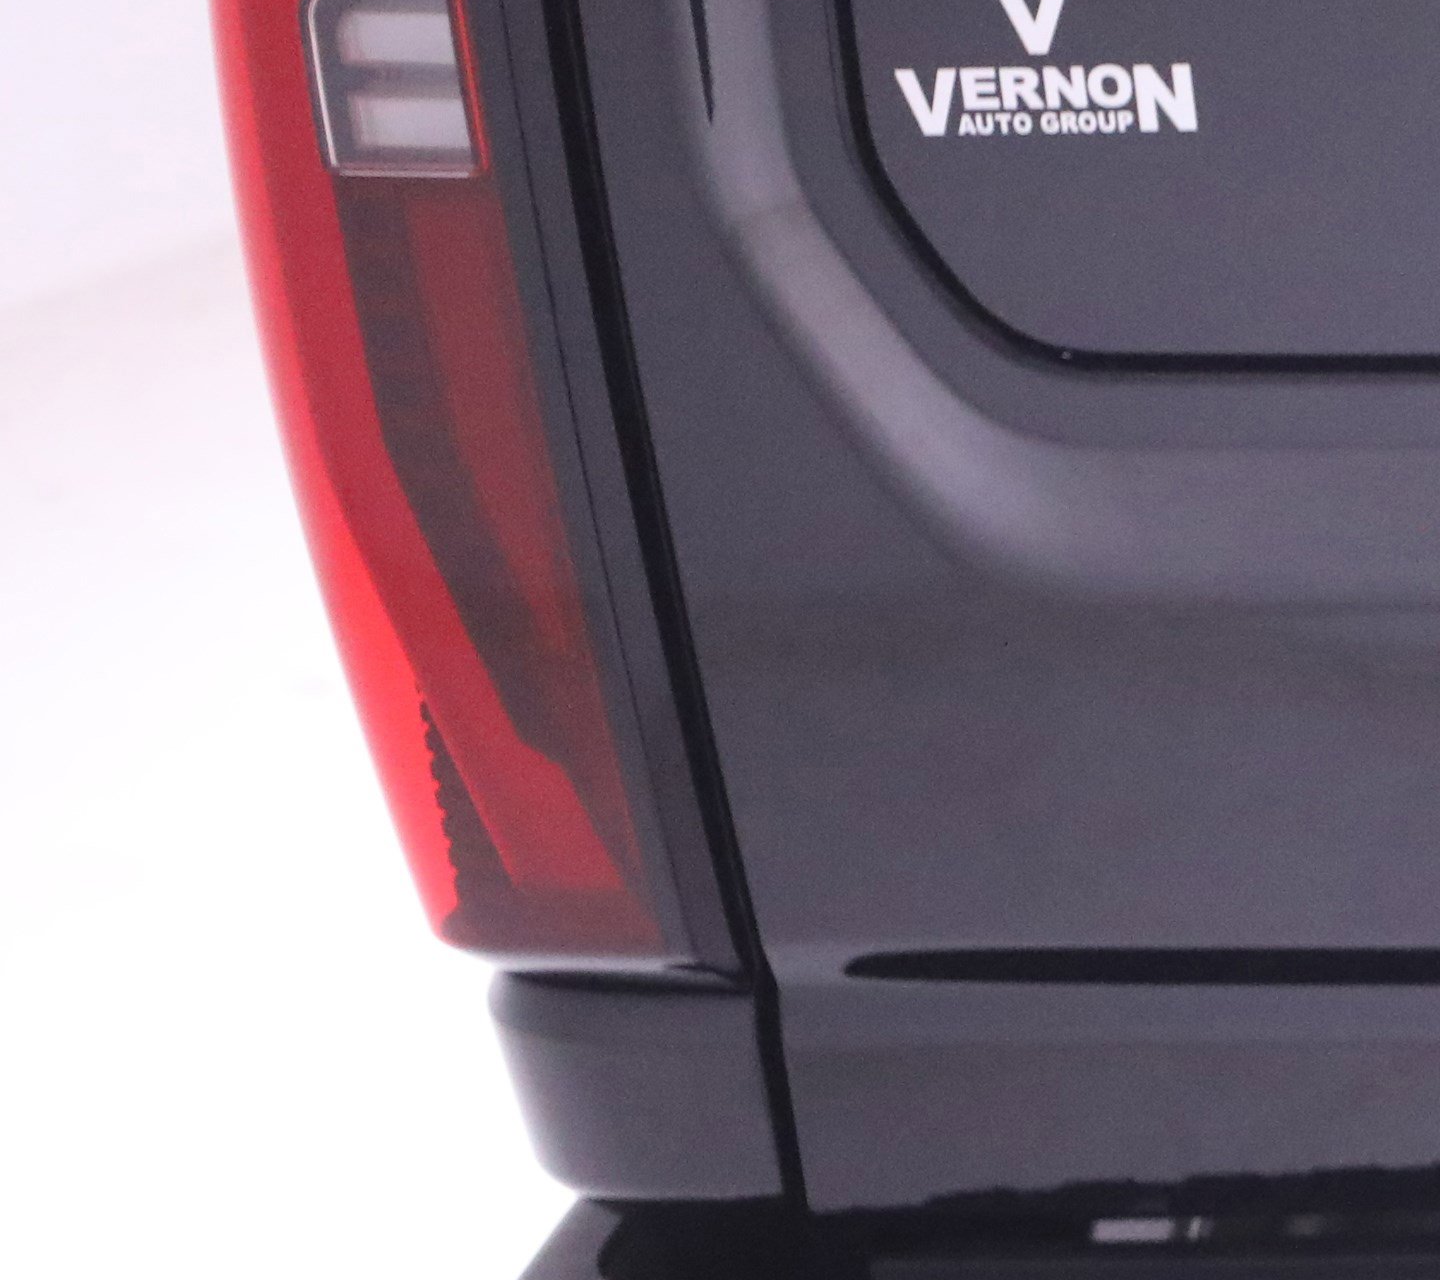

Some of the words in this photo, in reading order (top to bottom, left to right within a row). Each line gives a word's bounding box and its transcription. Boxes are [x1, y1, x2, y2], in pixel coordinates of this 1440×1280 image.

[894, 62, 1198, 137] VERNON
[958, 112, 1033, 136] AUTO
[1040, 110, 1134, 135] GROUP
